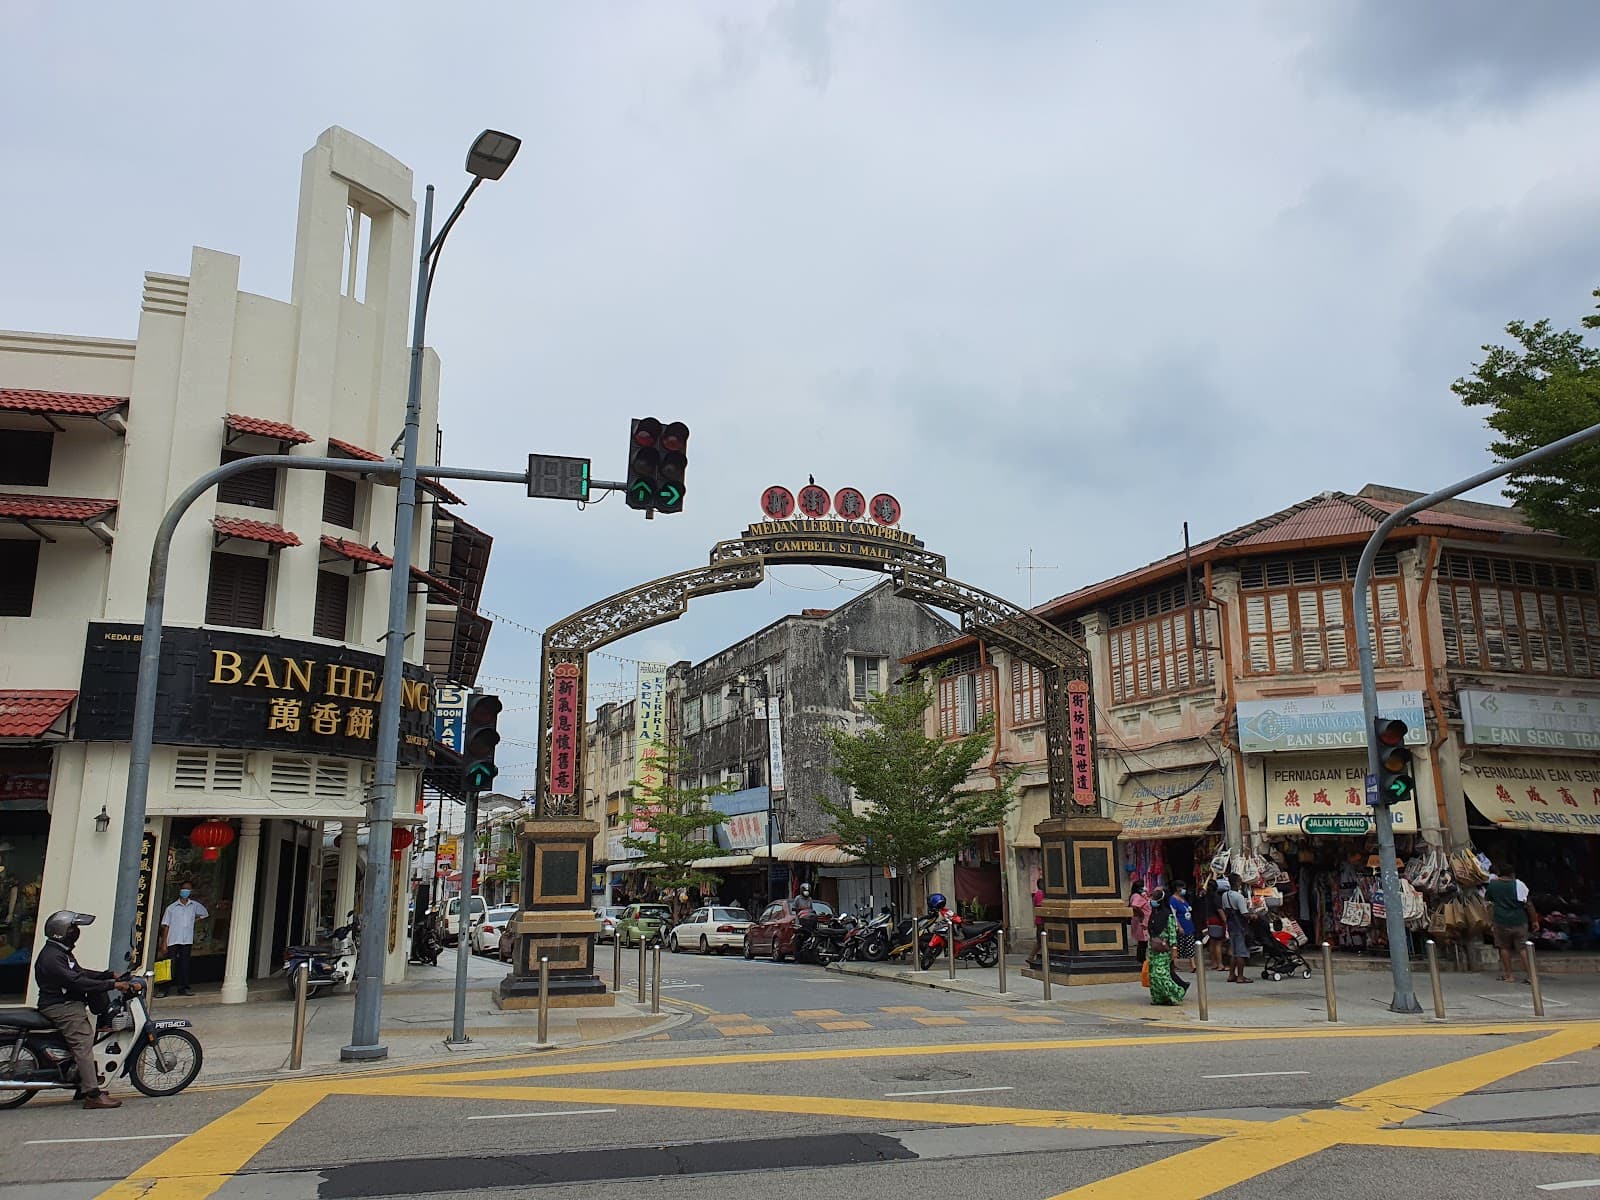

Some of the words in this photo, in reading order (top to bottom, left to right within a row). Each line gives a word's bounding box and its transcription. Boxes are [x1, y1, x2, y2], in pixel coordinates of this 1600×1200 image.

[750, 522, 798, 537] MEDAN
[802, 520, 845, 533] LEBUH
[850, 522, 915, 546] CAMPBELL
[774, 541, 835, 552] CAMPBELL
[840, 543, 853, 553] ST.
[859, 546, 892, 560] MALL
[104, 633, 131, 641] KEDAI
[209, 649, 316, 693] BAN
[639, 681, 651, 739] SENJIA
[268, 697, 374, 741] 萬香餅
[441, 719, 455, 750] FAR
[1287, 732, 1313, 746] EAN
[1318, 731, 1352, 745] SENG
[1491, 728, 1521, 744] EAN
[1527, 730, 1565, 746] SENG
[1274, 769, 1341, 782] PERNIAGAAN
[1346, 768, 1368, 780] EAN
[1474, 766, 1546, 781] PERNIAGAAN
[1549, 770, 1573, 782] EAN
[1277, 813, 1302, 826] EAN
[1309, 818, 1332, 828] JALAN
[1334, 818, 1365, 828] PENANG
[1505, 810, 1535, 823] EAN
[1536, 812, 1570, 825] SENG
